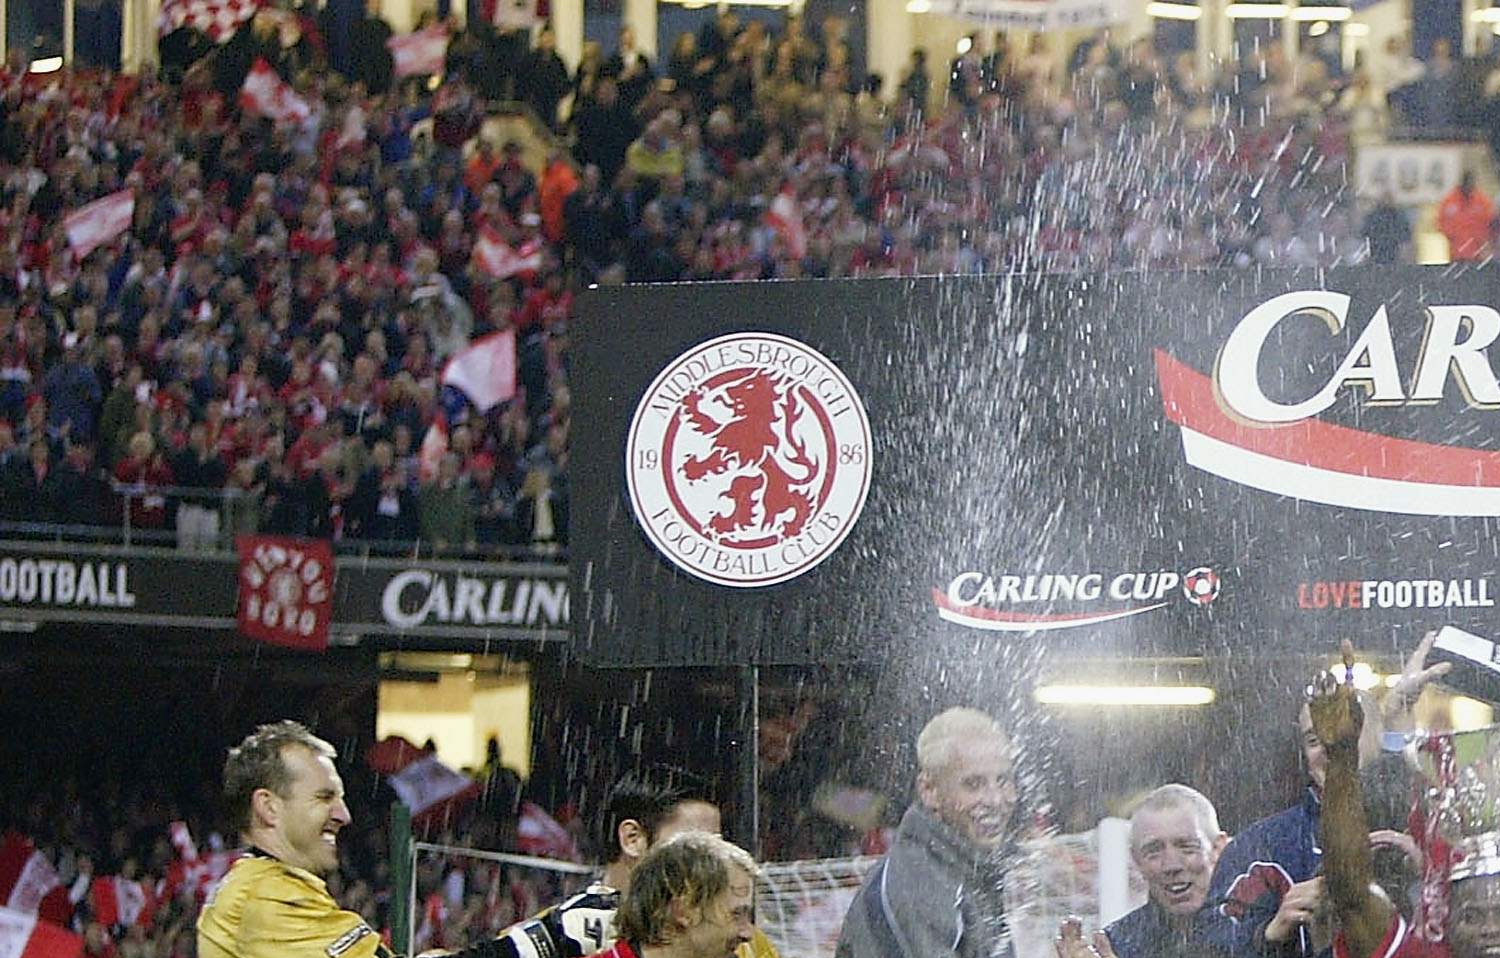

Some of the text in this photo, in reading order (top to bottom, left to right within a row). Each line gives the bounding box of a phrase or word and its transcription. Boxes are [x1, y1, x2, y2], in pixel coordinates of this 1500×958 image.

[651, 342, 851, 420] MIDDLESBROUGH
[637, 444, 863, 470] 19 86
[651, 508, 842, 575] FOOTBALL CLUB
[382, 570, 570, 628] CARLIN
[948, 571, 1179, 608] CARLING CUP
